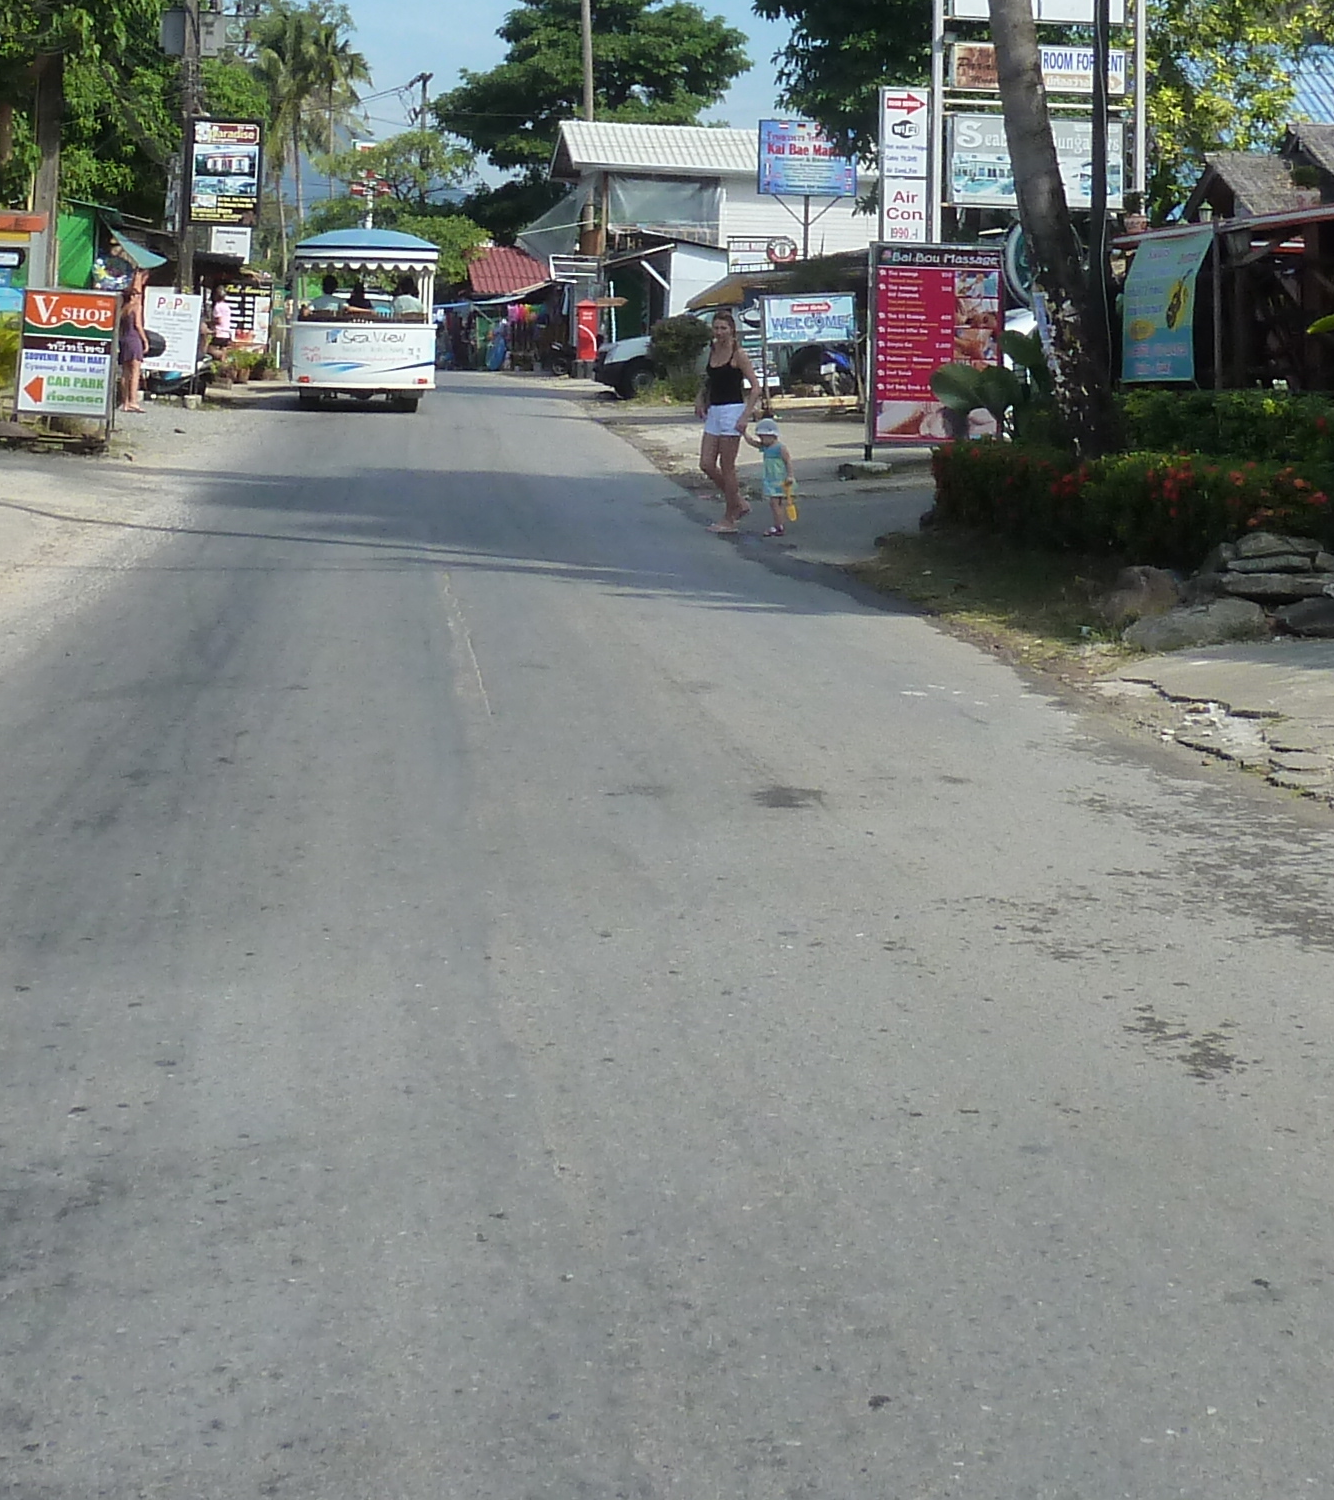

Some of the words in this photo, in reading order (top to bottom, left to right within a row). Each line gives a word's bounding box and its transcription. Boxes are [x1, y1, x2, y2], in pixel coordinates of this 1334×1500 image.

[1043, 52, 1073, 70] ROOM
[893, 191, 918, 203] Air
[886, 207, 924, 220] Con
[943, 253, 999, 266] Massage
[157, 297, 192, 311] PaPa
[61, 306, 112, 322] SHOP
[771, 315, 846, 331] WELCOME
[25, 352, 58, 362] SOUVENIR
[87, 356, 107, 365] MART
[47, 376, 71, 387] CAR
[74, 378, 105, 389] PARK
